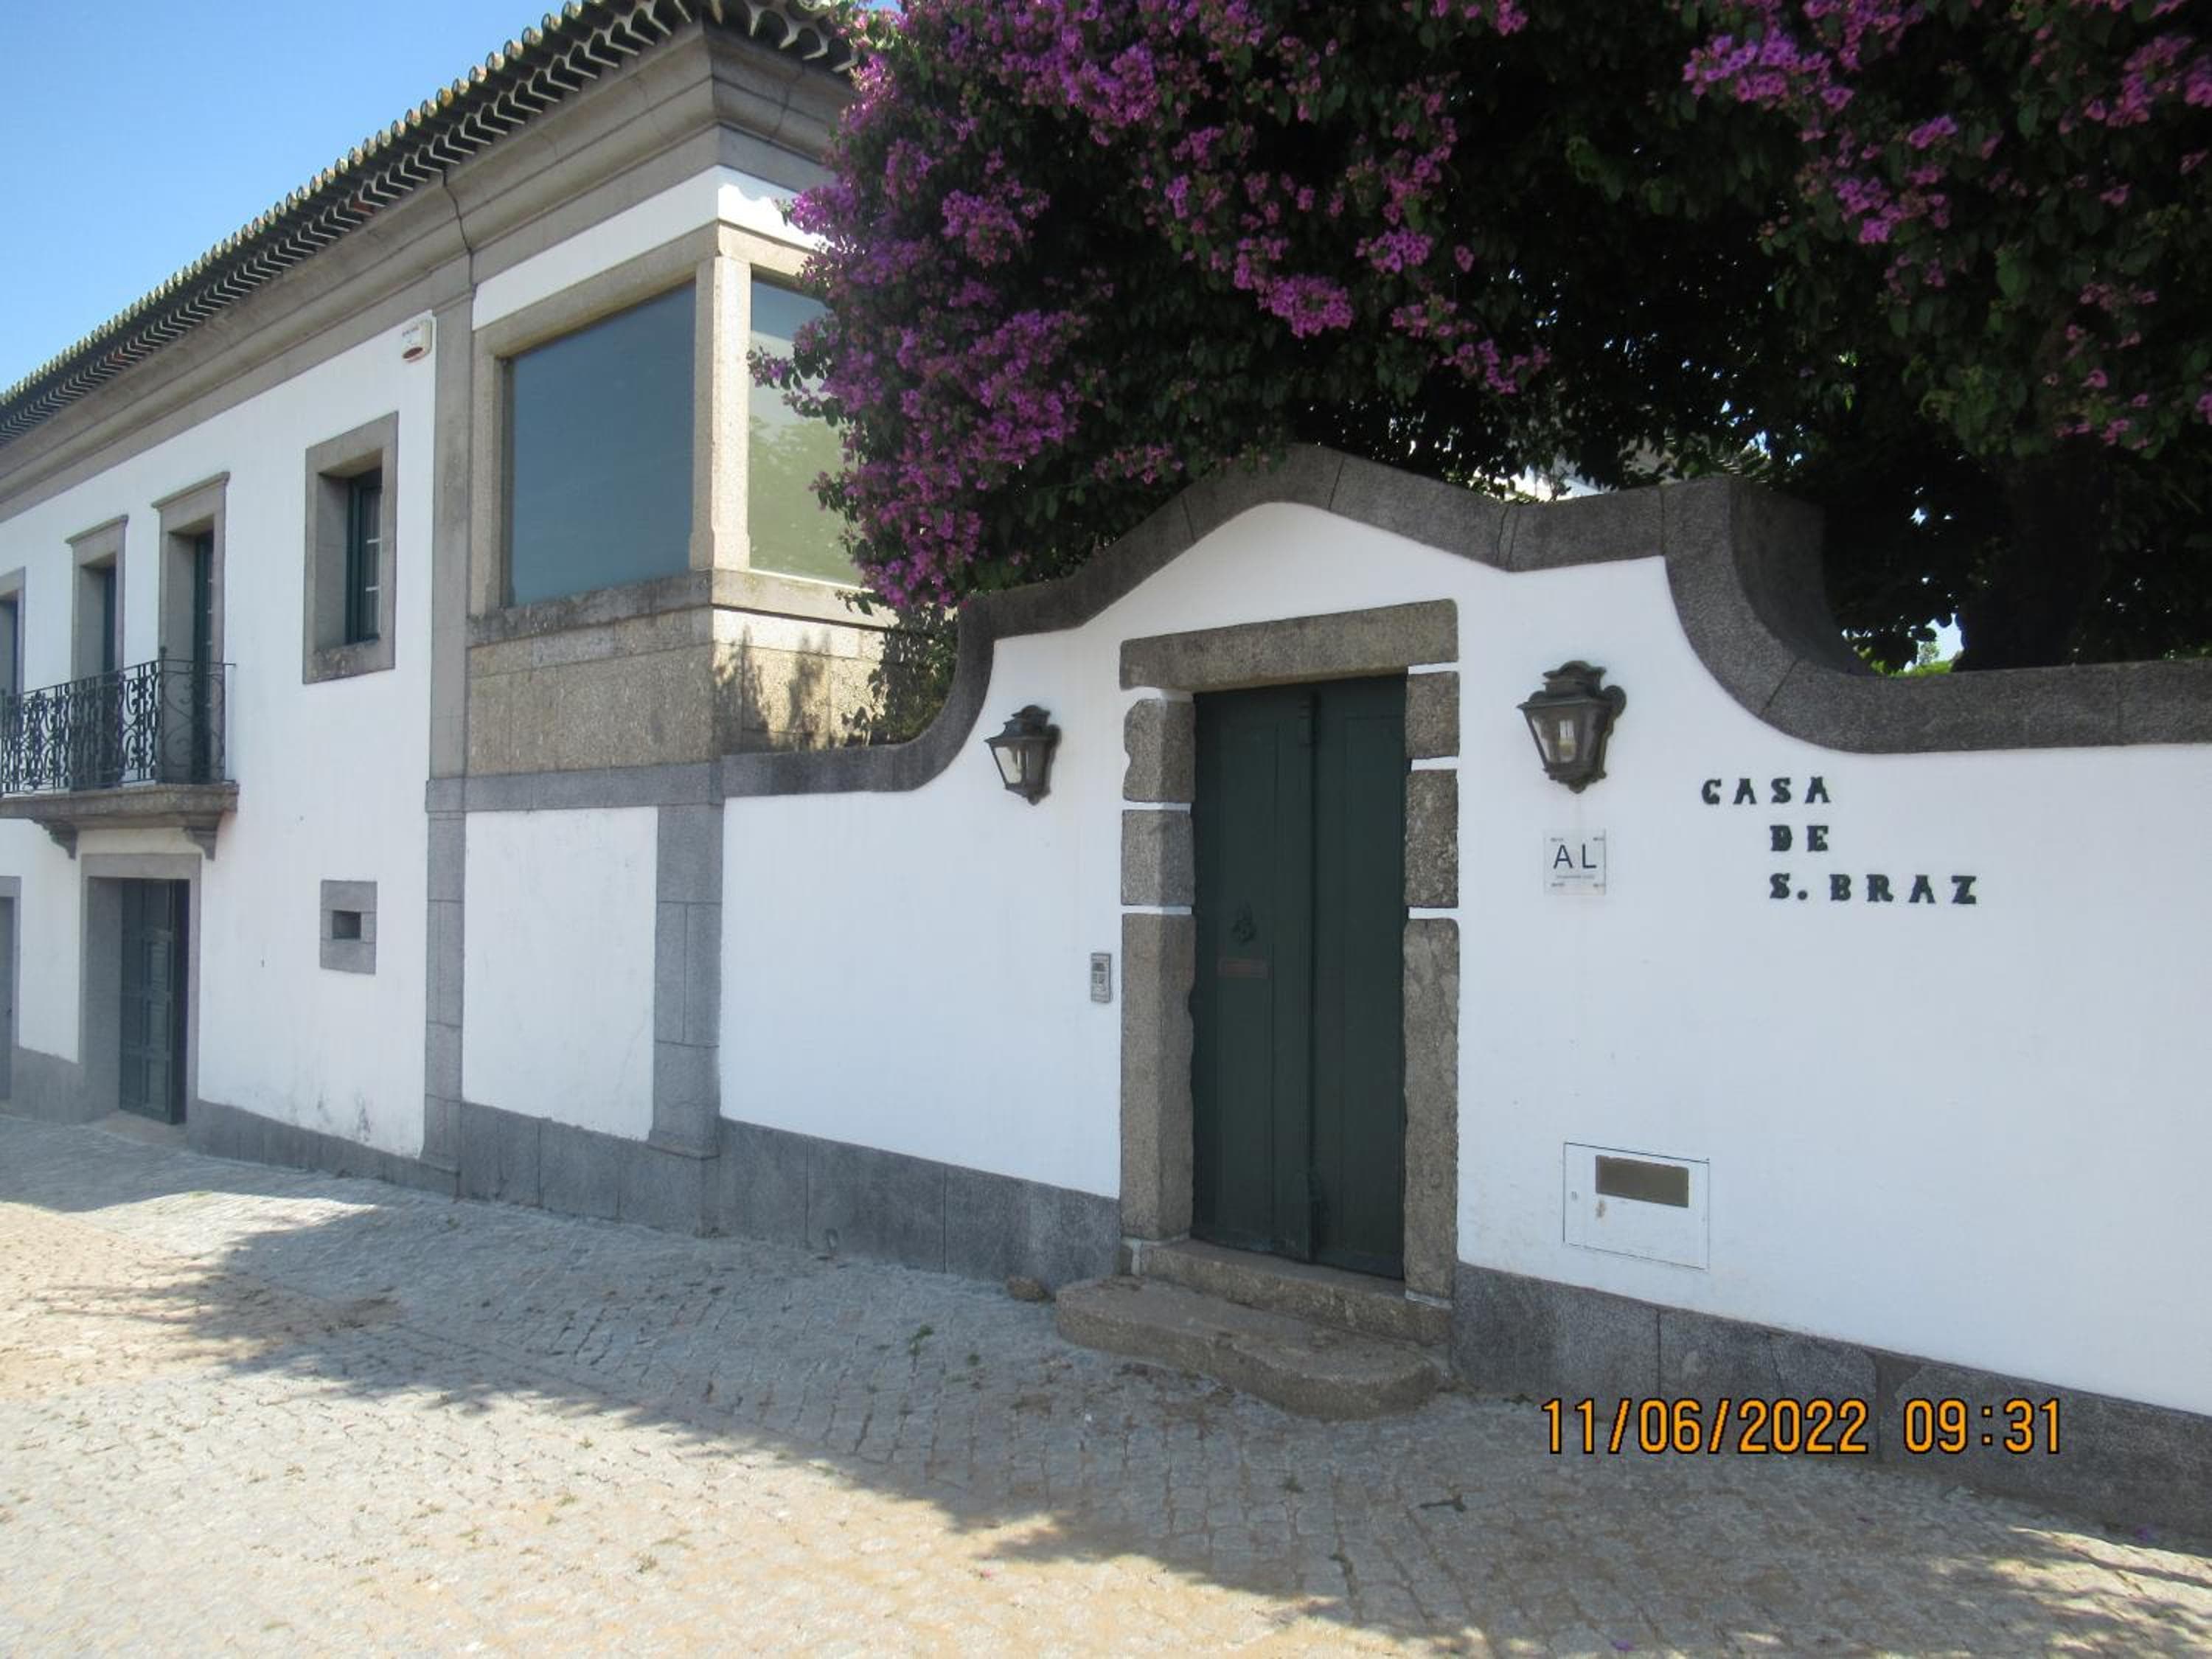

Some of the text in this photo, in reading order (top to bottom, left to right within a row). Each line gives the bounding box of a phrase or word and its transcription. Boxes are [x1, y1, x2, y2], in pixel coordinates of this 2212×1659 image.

[1701, 776, 1832, 805] CASA
[1770, 824, 1829, 852] DE
[1553, 844, 1597, 869] AL
[1770, 872, 1978, 905] S. BRAZ
